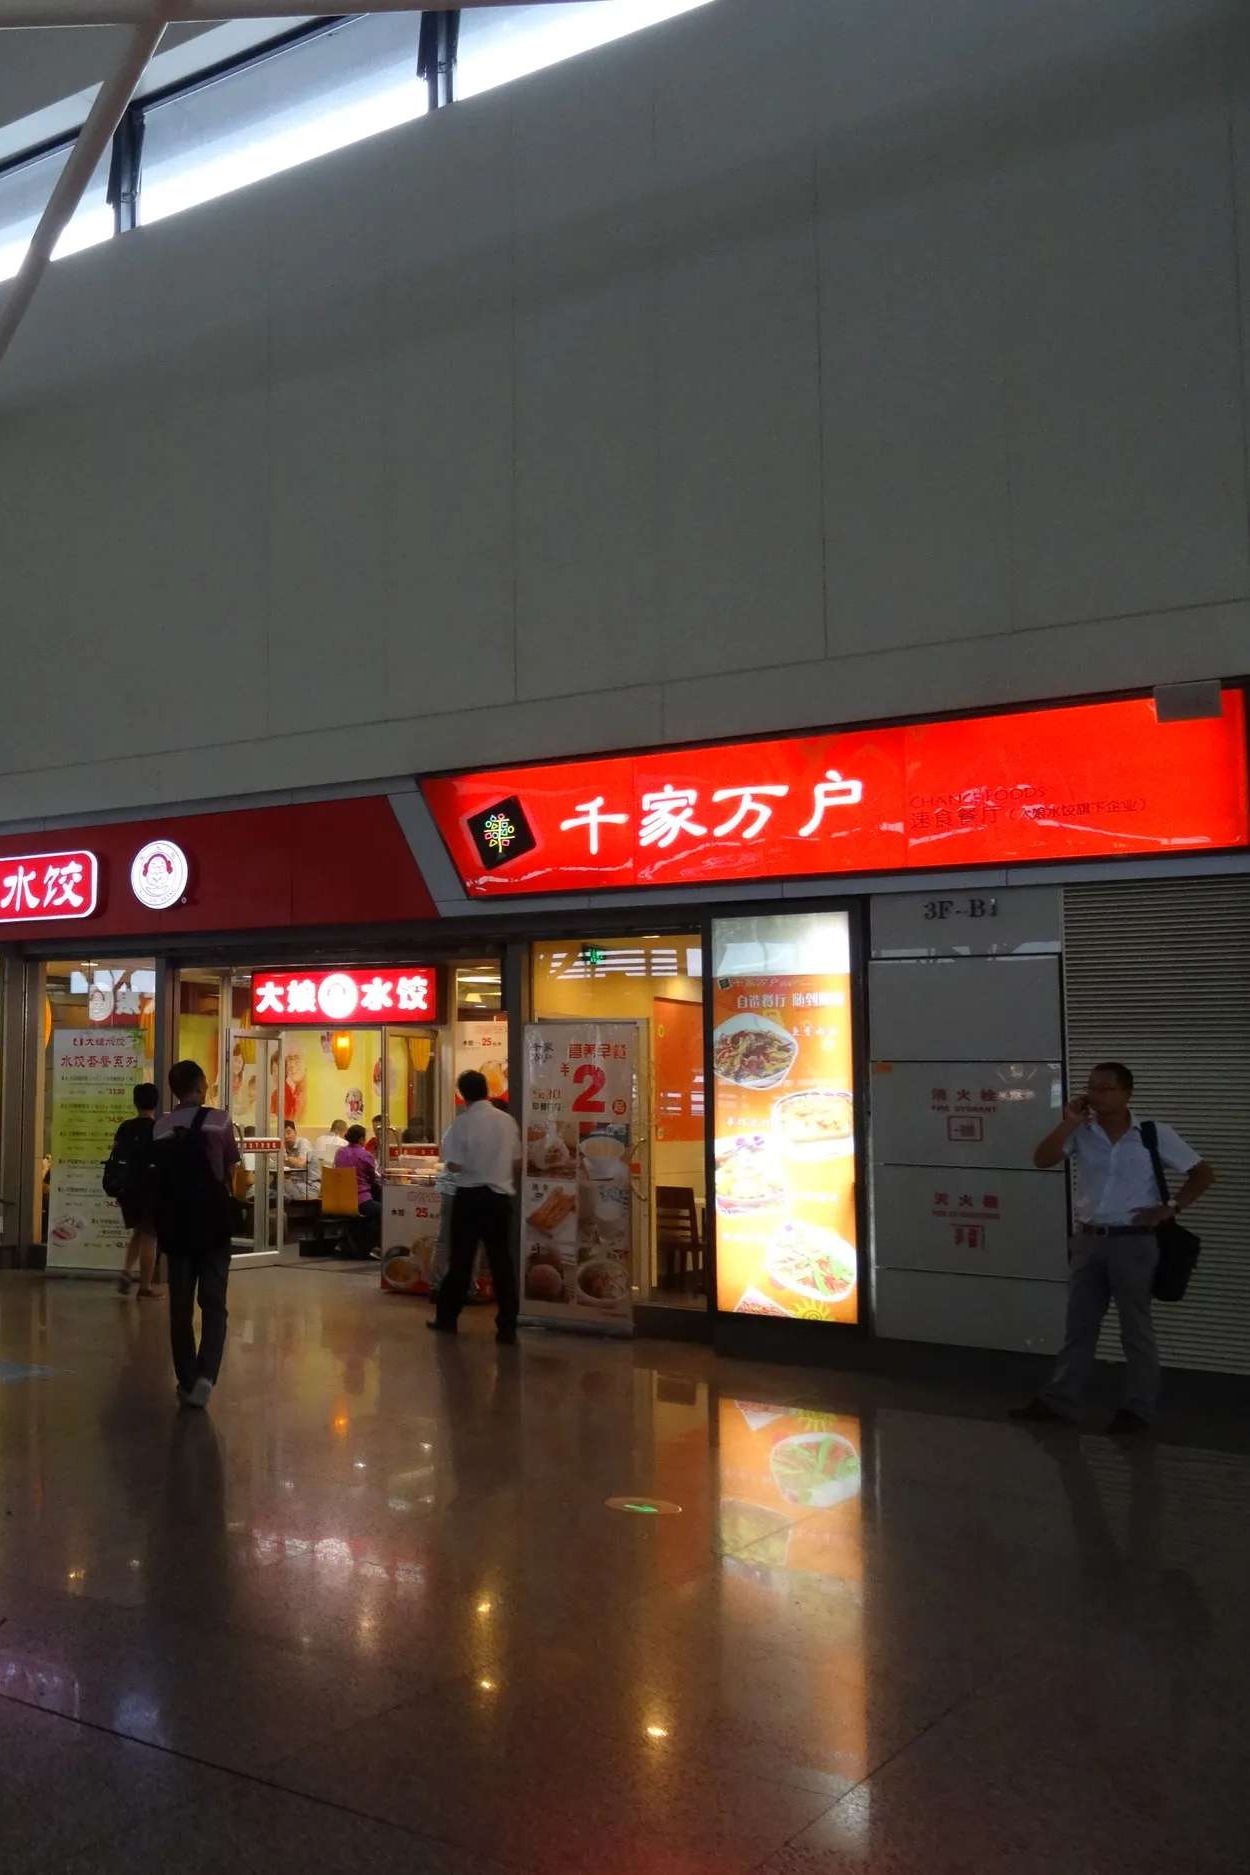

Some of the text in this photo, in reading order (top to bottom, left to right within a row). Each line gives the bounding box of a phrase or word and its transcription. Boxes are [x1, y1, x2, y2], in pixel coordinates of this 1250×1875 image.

[560, 769, 862, 855] 千家万户
[415, 1207, 429, 1218] 25
